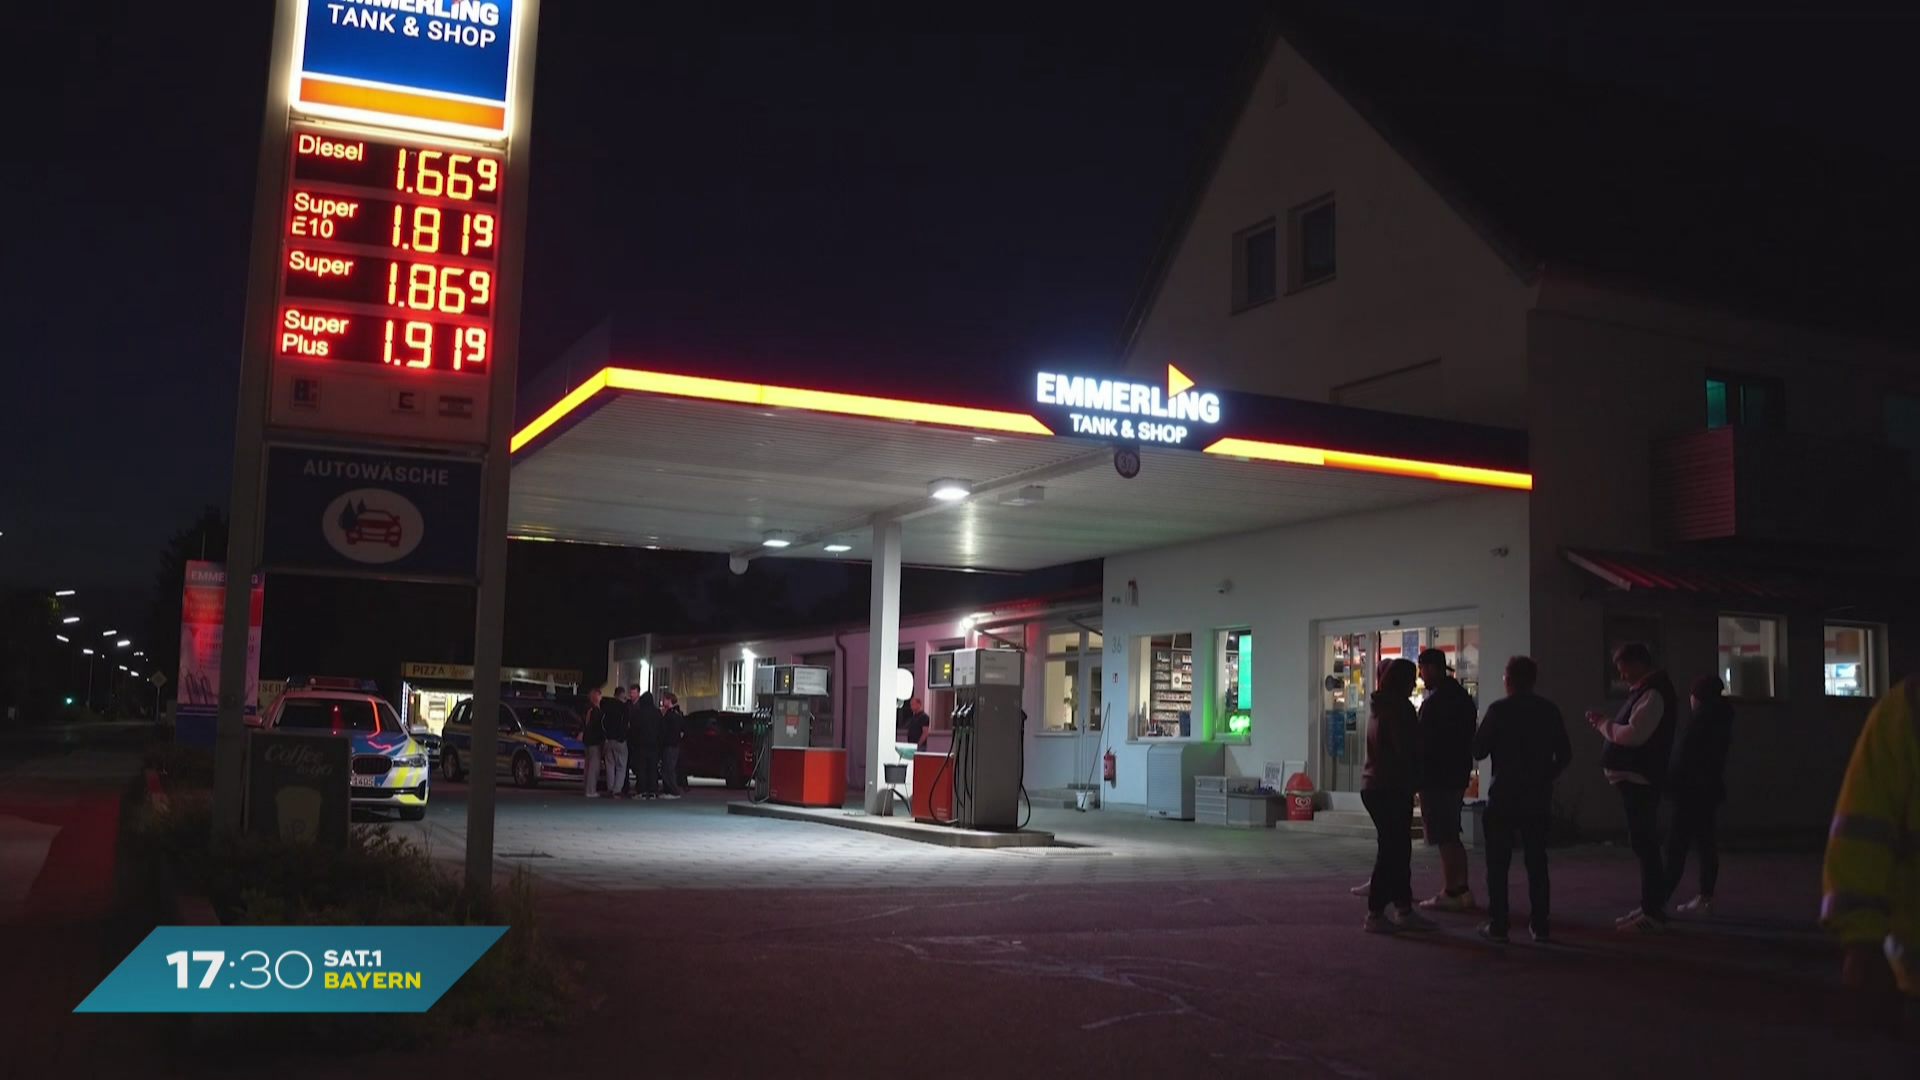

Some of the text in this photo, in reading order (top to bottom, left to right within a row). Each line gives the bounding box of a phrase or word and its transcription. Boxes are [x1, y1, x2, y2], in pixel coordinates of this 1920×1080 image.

[327, 3, 496, 48] TANK & SHOP
[298, 135, 363, 161] Diesel
[294, 193, 358, 218] Super
[291, 216, 334, 238] E10
[289, 251, 353, 277] Super
[284, 310, 349, 335] Super
[281, 333, 329, 356] Plus
[1037, 372, 1220, 423] EMMERLING
[1069, 413, 1187, 444] TANK & SHOP
[303, 459, 449, 485] AUTOWÄSCHE
[412, 664, 445, 676] PIZZA
[264, 743, 324, 766] Coffee
